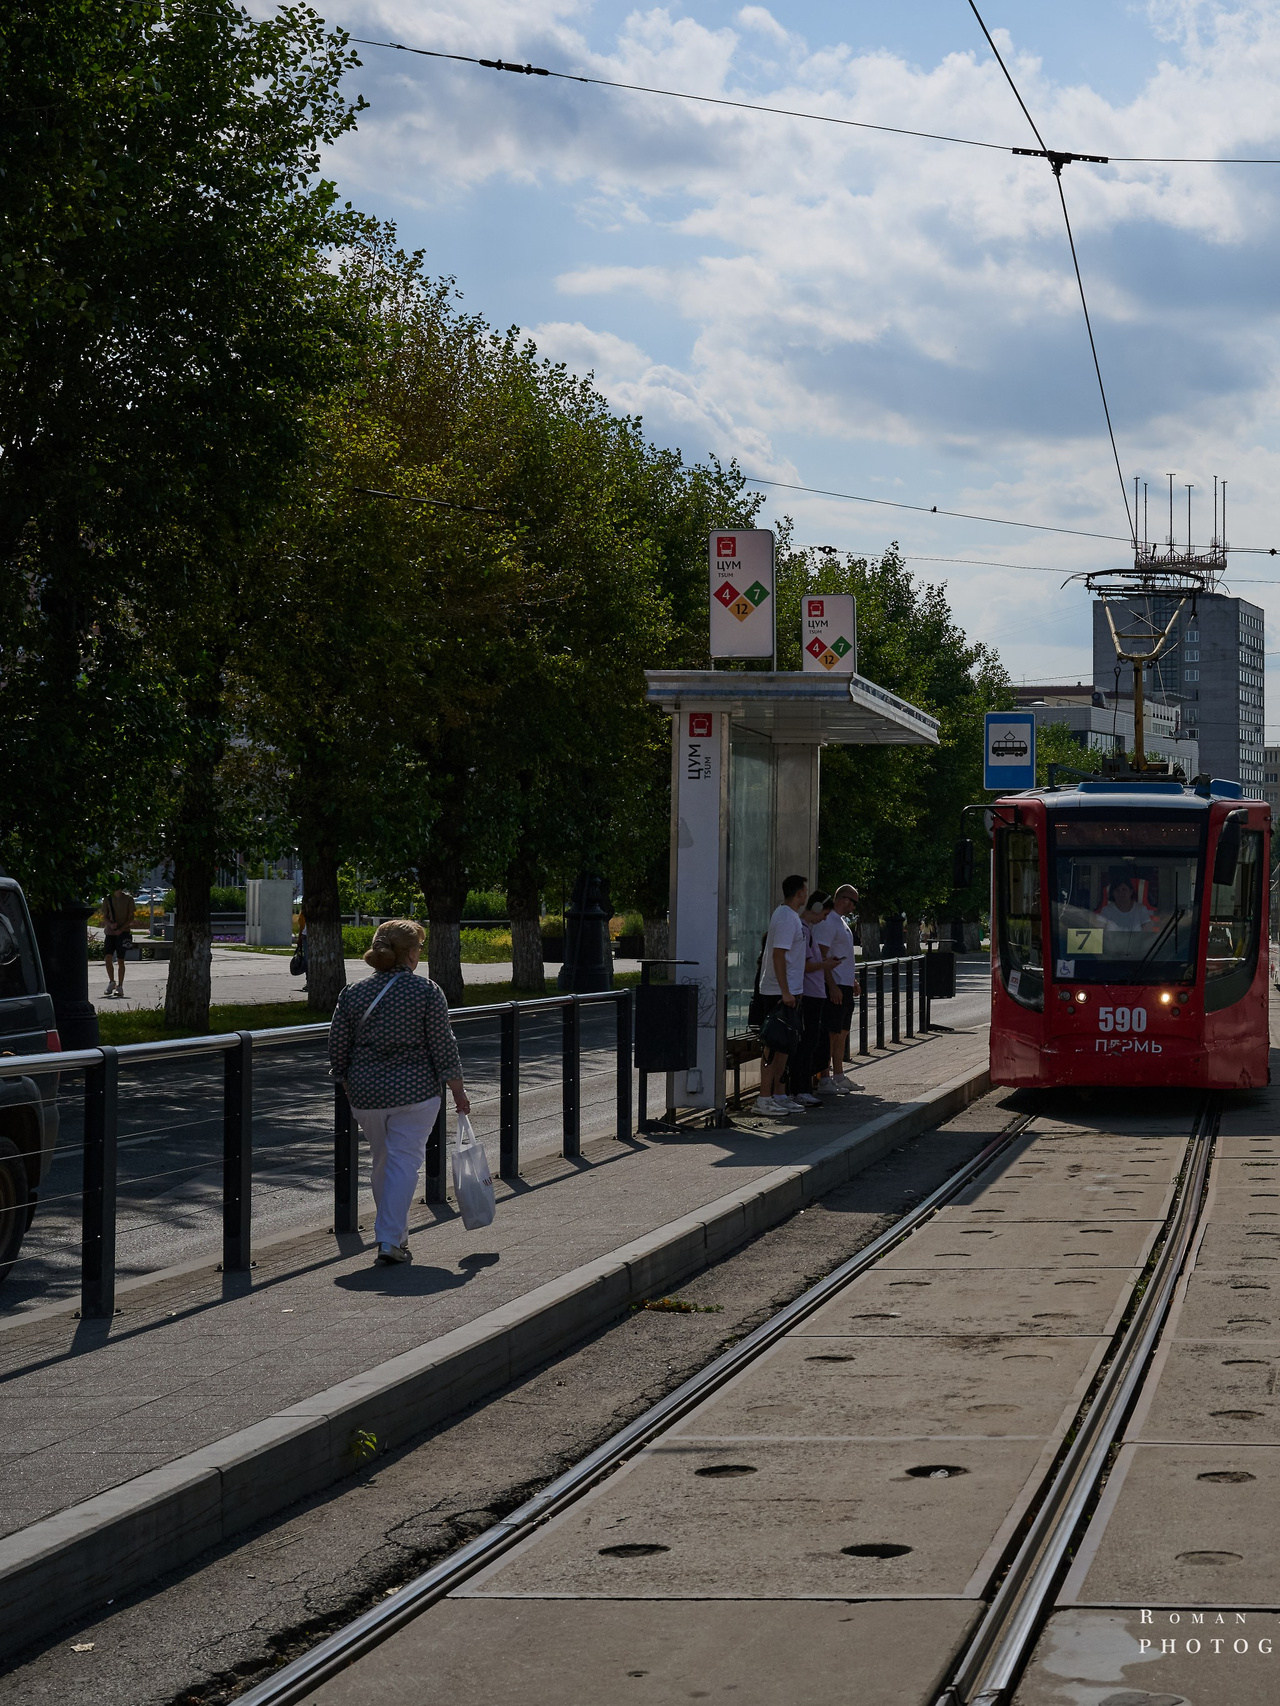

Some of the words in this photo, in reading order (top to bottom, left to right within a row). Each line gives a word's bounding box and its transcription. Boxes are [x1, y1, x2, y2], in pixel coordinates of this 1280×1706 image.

[717, 561, 741, 572] ЦУМ
[722, 589, 730, 599] 4
[753, 589, 761, 599] 7
[735, 604, 748, 614] 12
[808, 620, 829, 629] ЦУМ
[813, 643, 820, 652] 4
[838, 643, 845, 652] 7
[823, 655, 834, 664] 12
[688, 744, 701, 780] ЦУМ
[704, 756, 712, 778] TSUM
[1075, 930, 1092, 950] 7
[1099, 1007, 1147, 1033] 590
